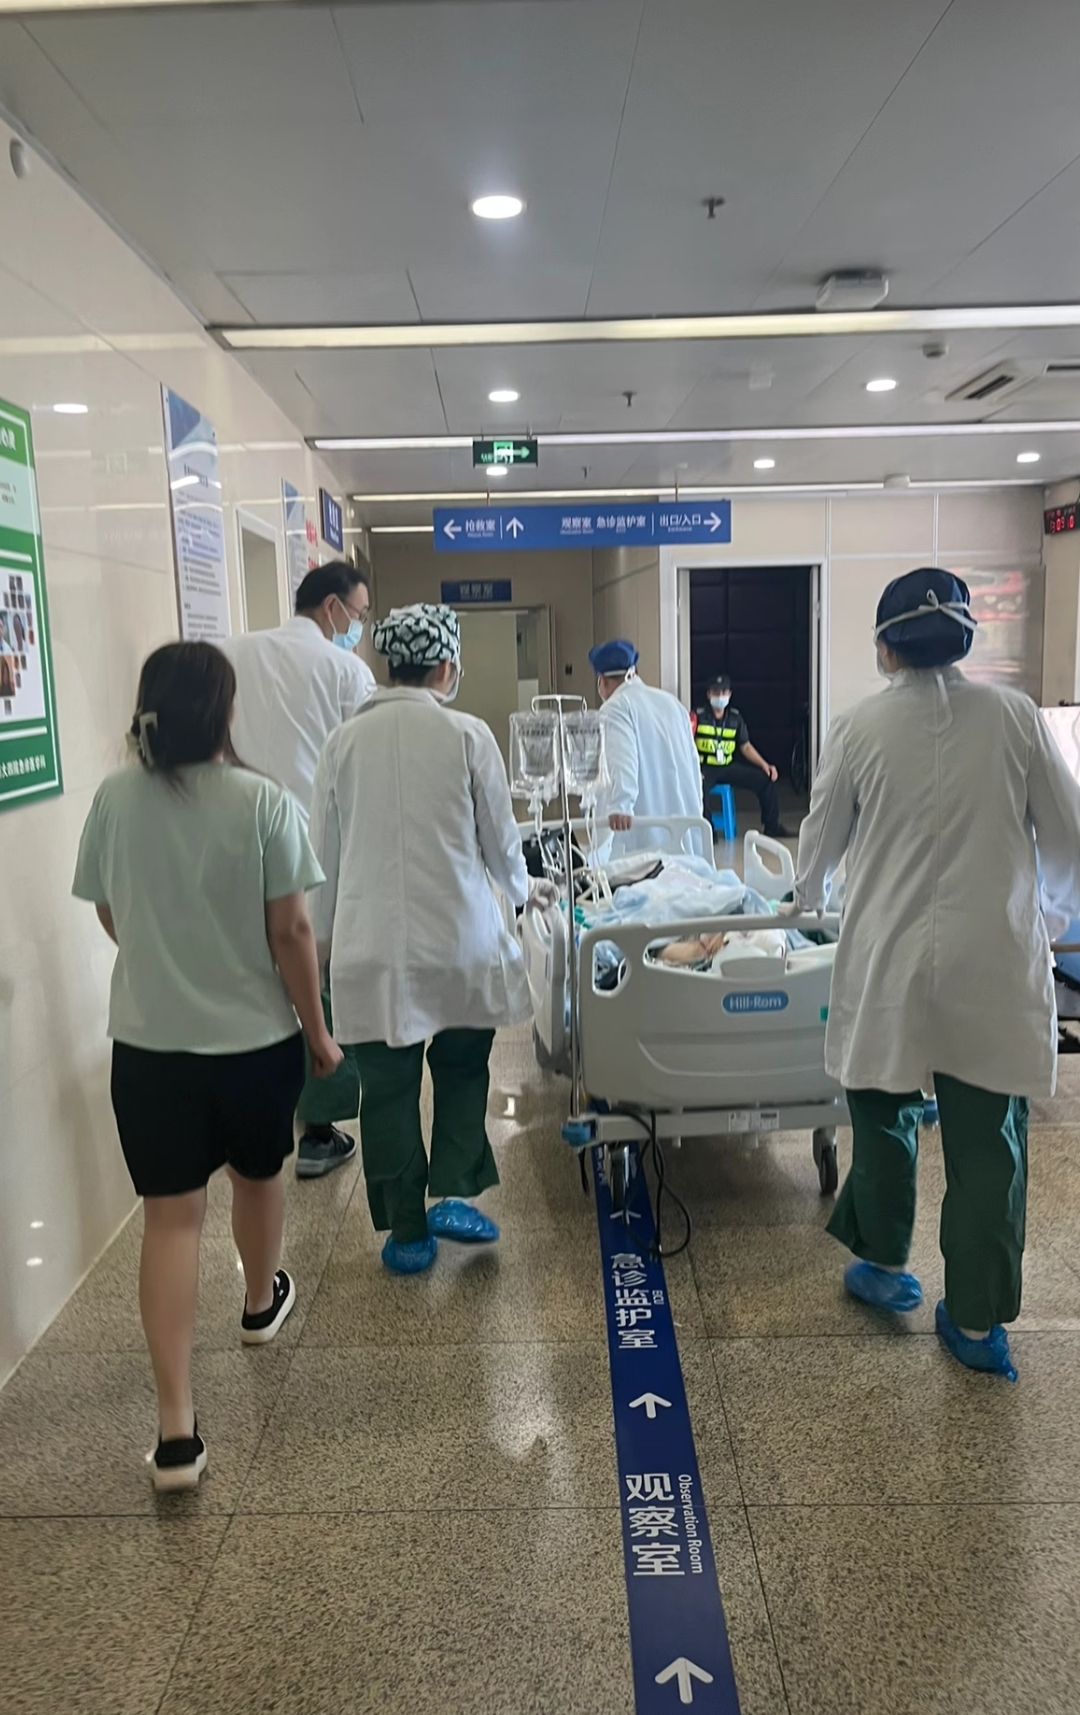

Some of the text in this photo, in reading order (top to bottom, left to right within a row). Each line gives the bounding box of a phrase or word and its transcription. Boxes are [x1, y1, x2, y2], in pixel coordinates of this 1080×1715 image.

[596, 514, 646, 529] 急诊监护室
[660, 513, 701, 527] 出口/入口
[610, 1252, 658, 1349] 急诊监护室
[625, 1472, 686, 1576] 观察室
[678, 1474, 704, 1574] Observation Room
